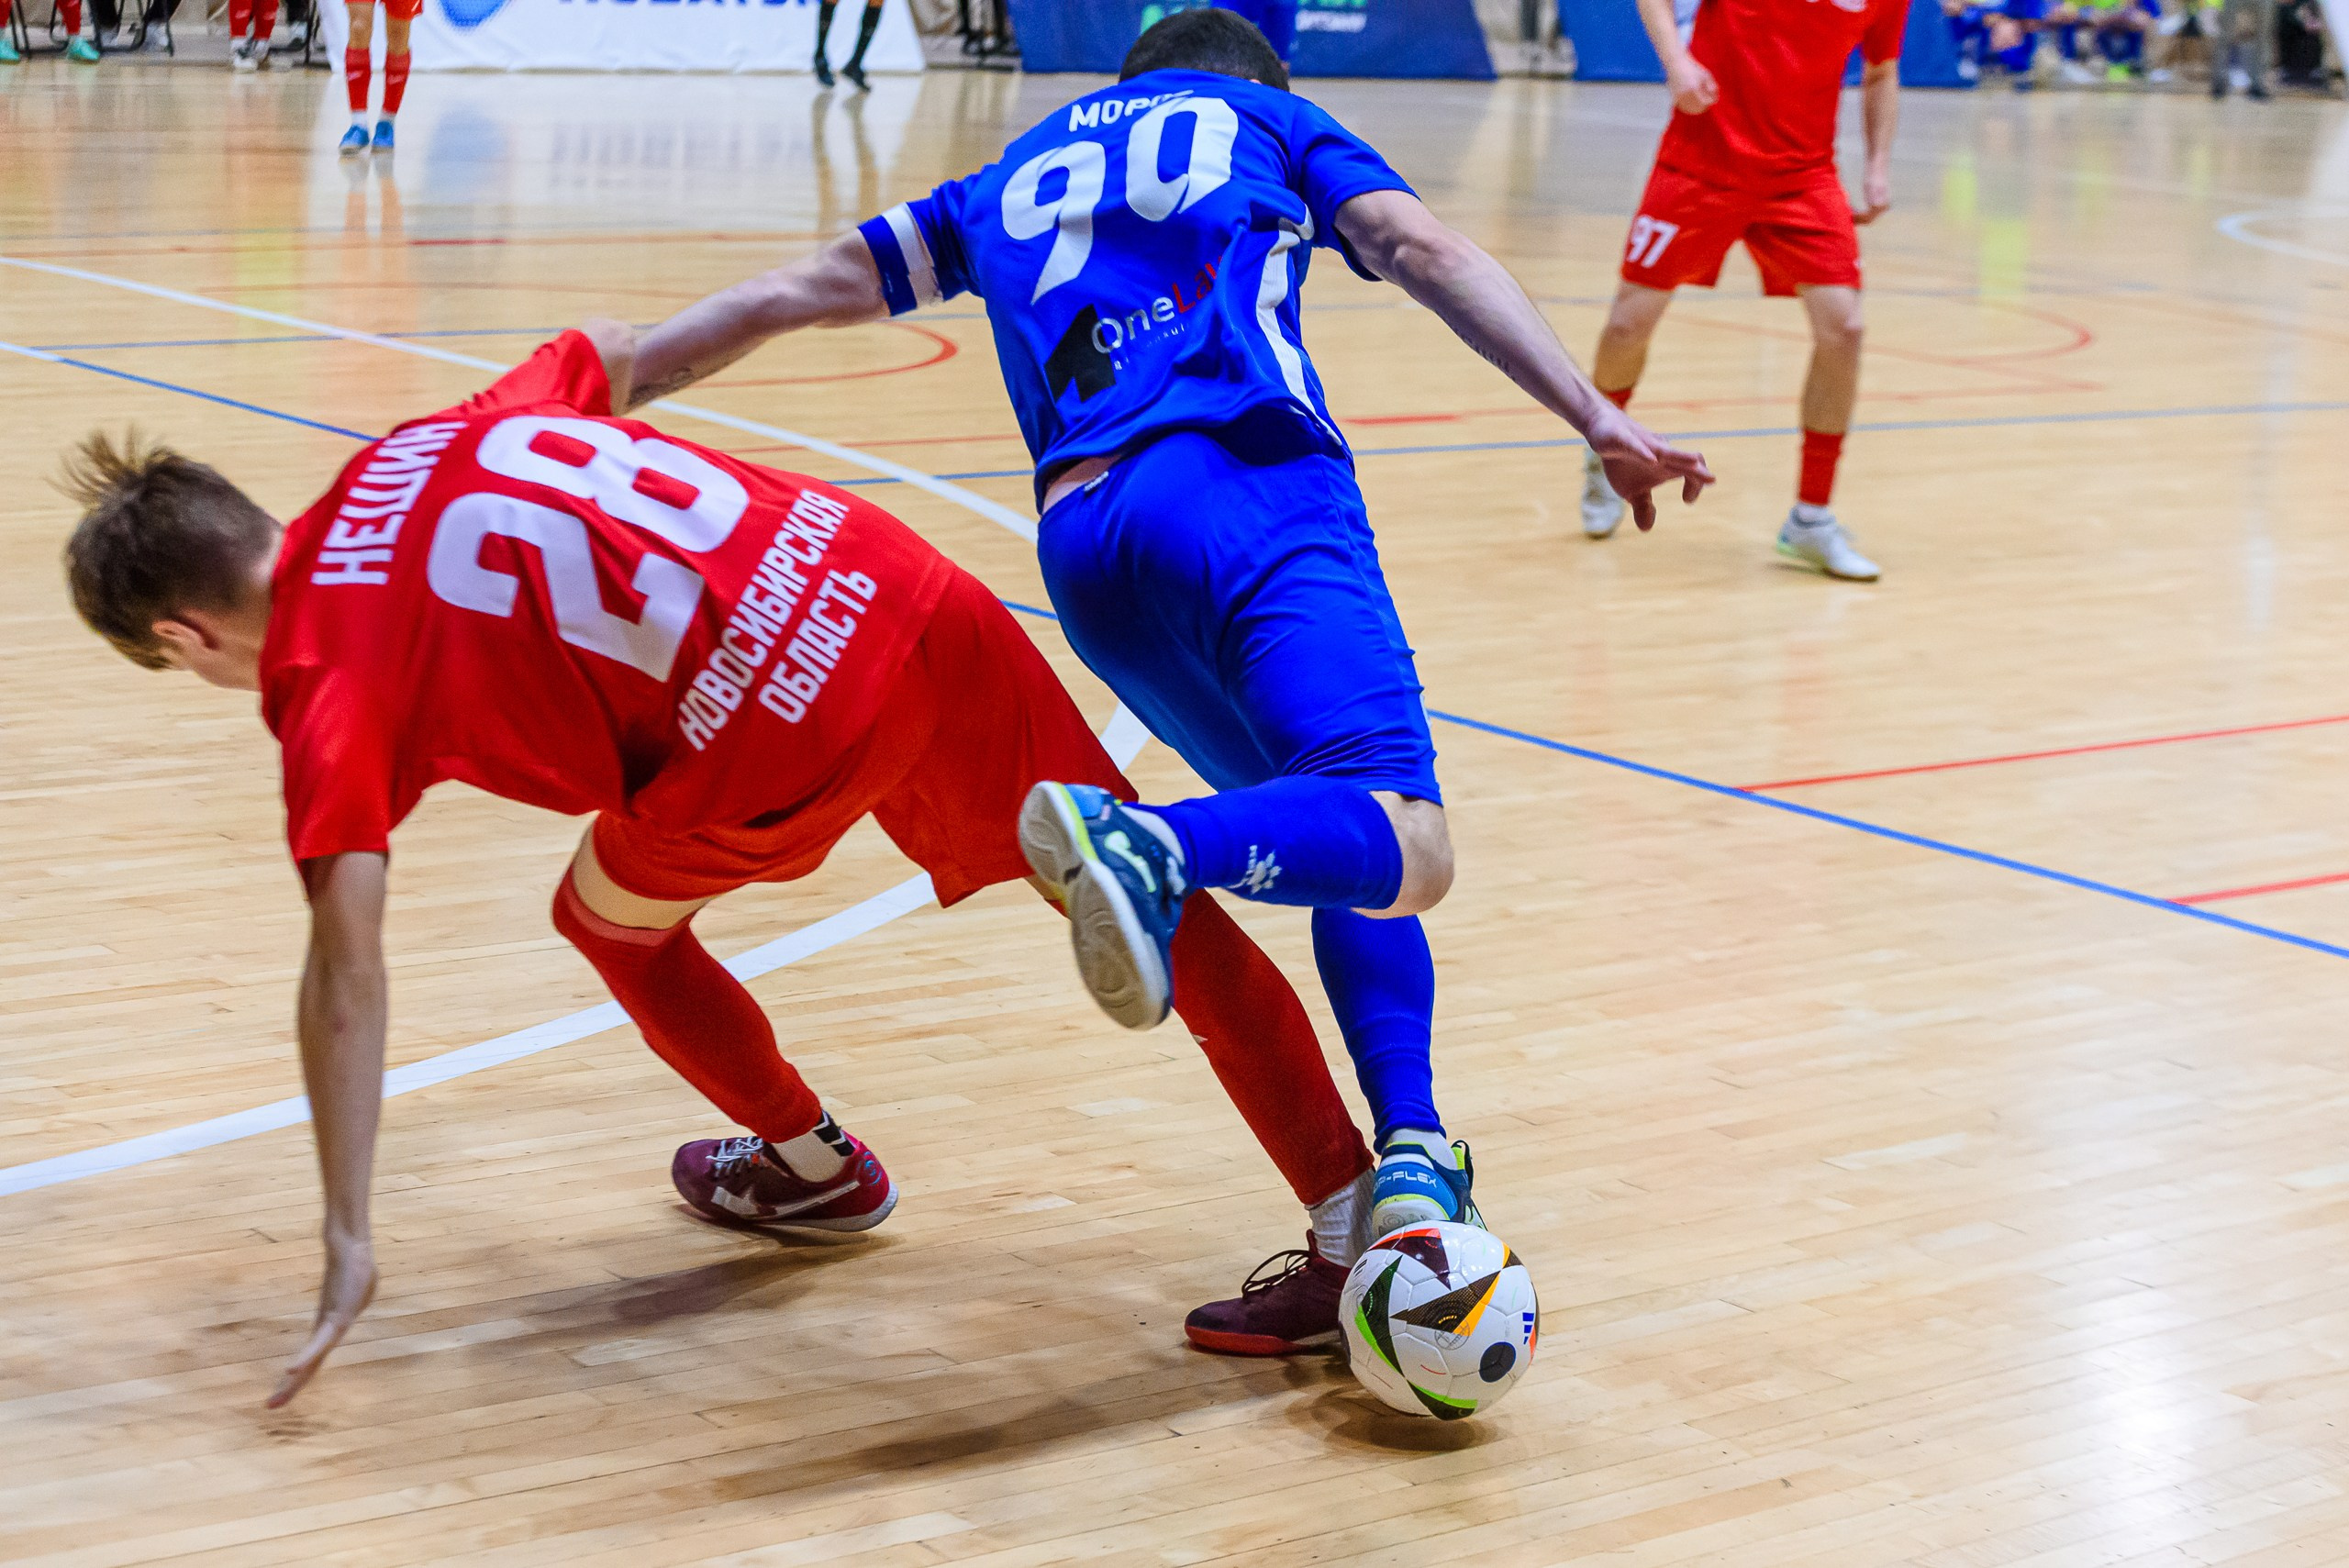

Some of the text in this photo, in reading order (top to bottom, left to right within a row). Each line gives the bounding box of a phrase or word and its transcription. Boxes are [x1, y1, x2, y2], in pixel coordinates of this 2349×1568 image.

[1001, 95, 1239, 305] 90
[1626, 215, 1680, 268] 97
[1091, 256, 1222, 354] OneLa
[427, 416, 750, 683] 28
[678, 488, 850, 751] НОВОСИБИРСКАЯ
[758, 568, 877, 724] ОБЛАСТЬ
